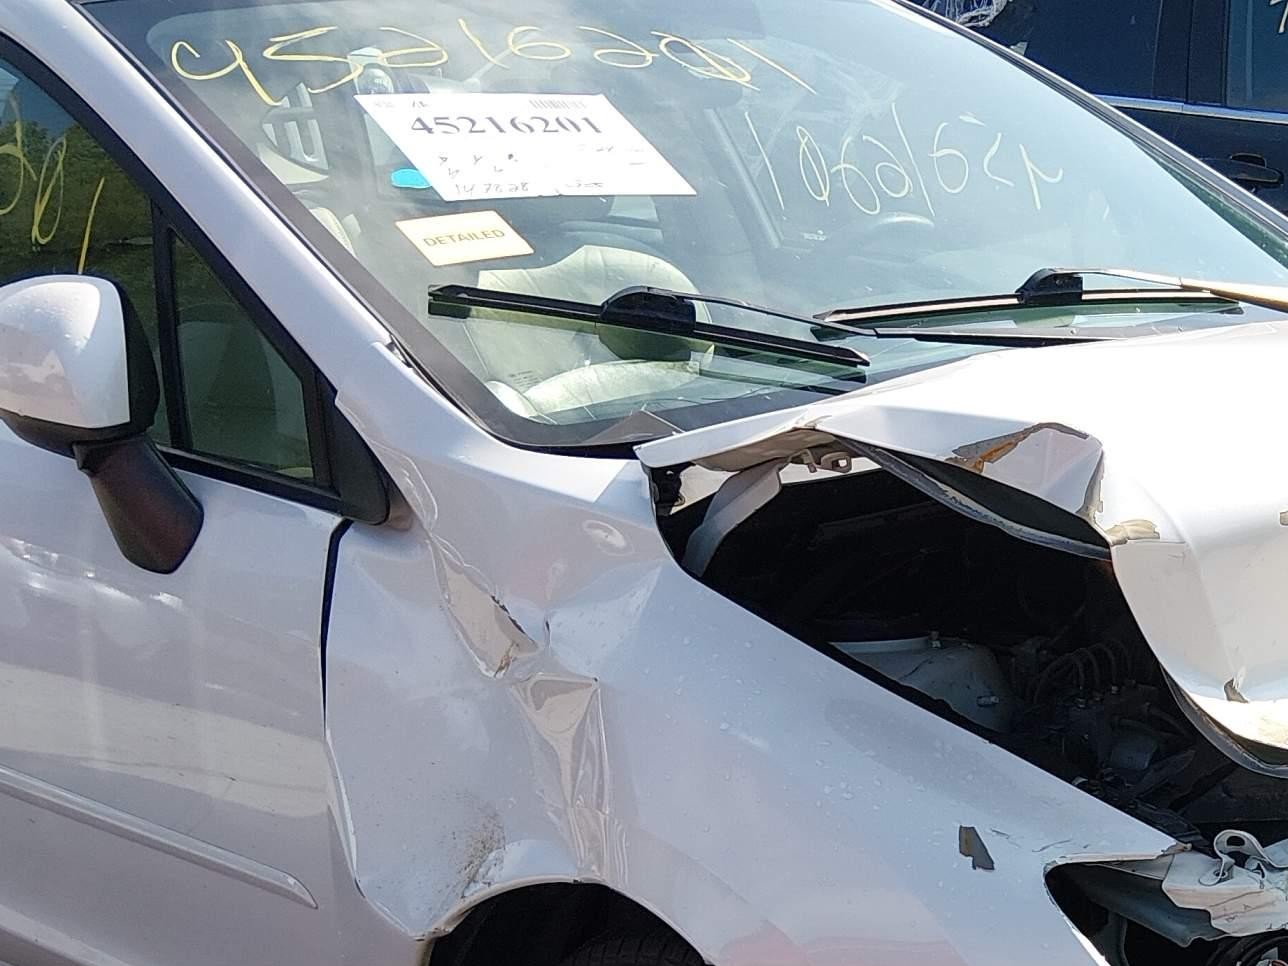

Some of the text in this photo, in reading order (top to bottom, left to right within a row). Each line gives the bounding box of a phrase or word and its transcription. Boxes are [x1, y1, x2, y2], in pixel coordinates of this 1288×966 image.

[171, 18, 817, 106] 45216201
[410, 115, 603, 136] 45216201
[423, 228, 506, 248] DETAILED
